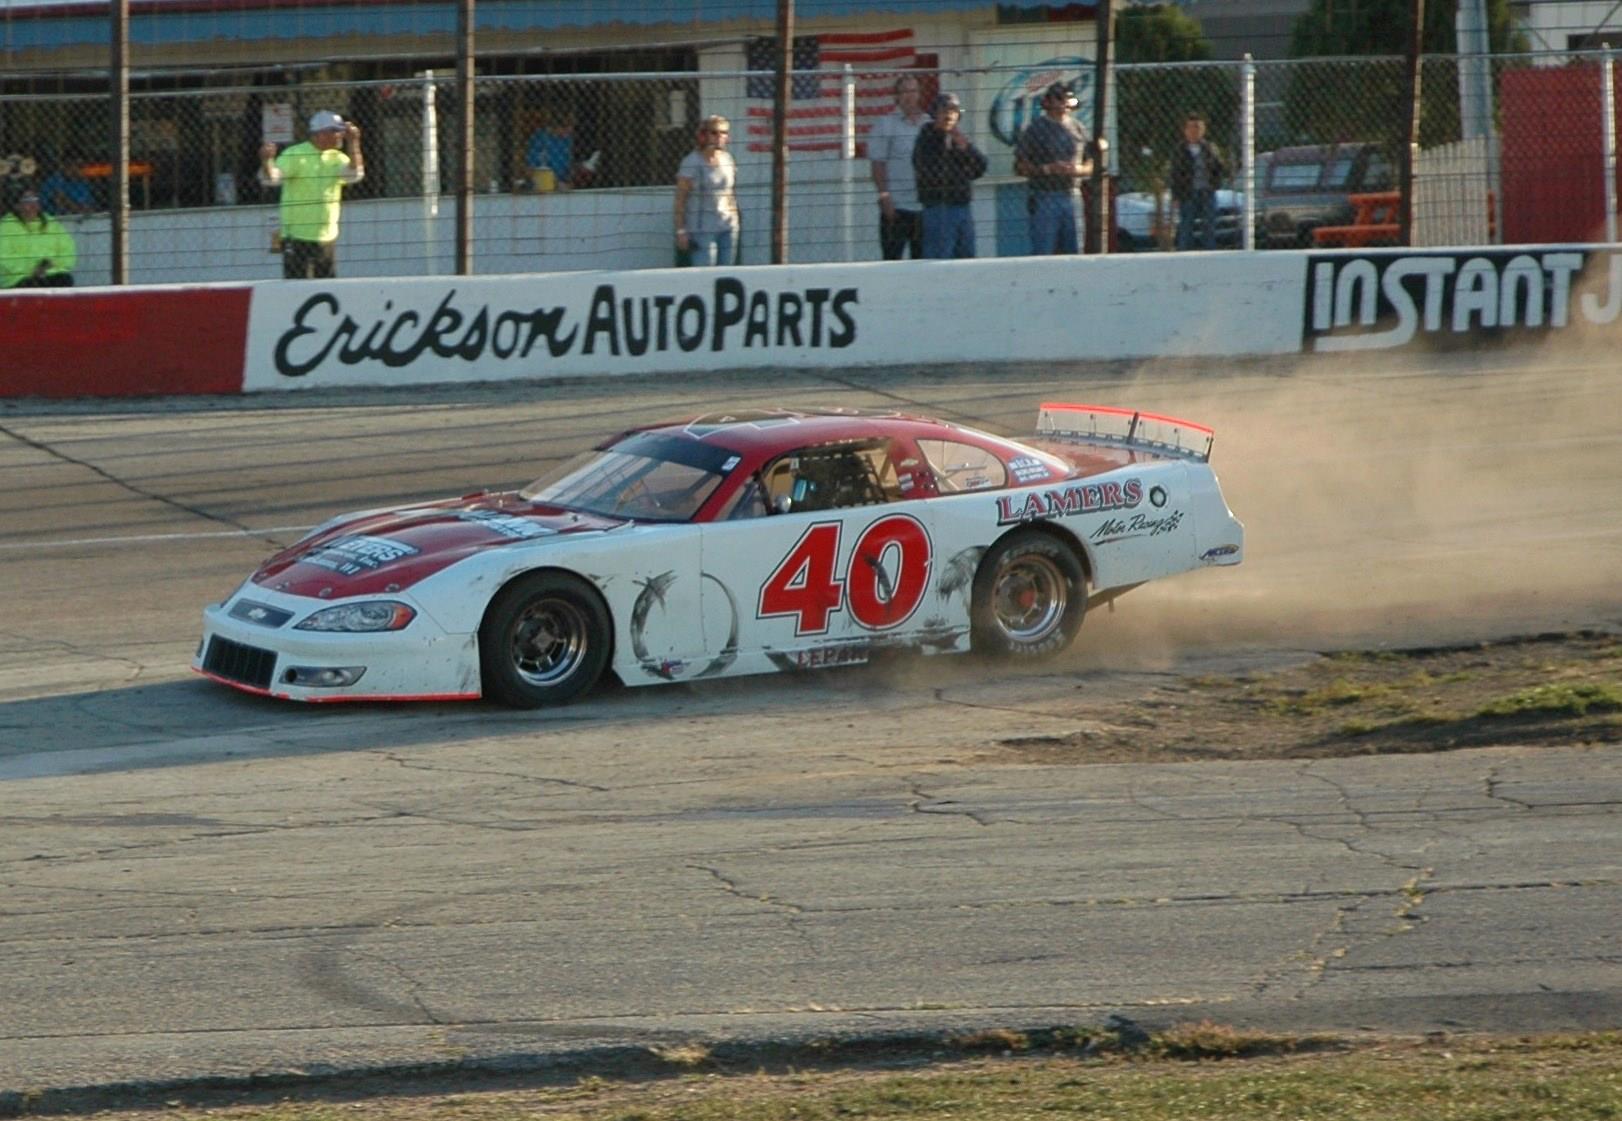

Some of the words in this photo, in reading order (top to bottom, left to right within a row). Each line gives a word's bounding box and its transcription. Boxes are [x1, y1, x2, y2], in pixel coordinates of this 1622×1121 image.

[273, 288, 579, 377] Erickson
[1312, 252, 1584, 352] INSTANT
[996, 478, 1144, 527] LAMERS
[756, 512, 933, 638] 40
